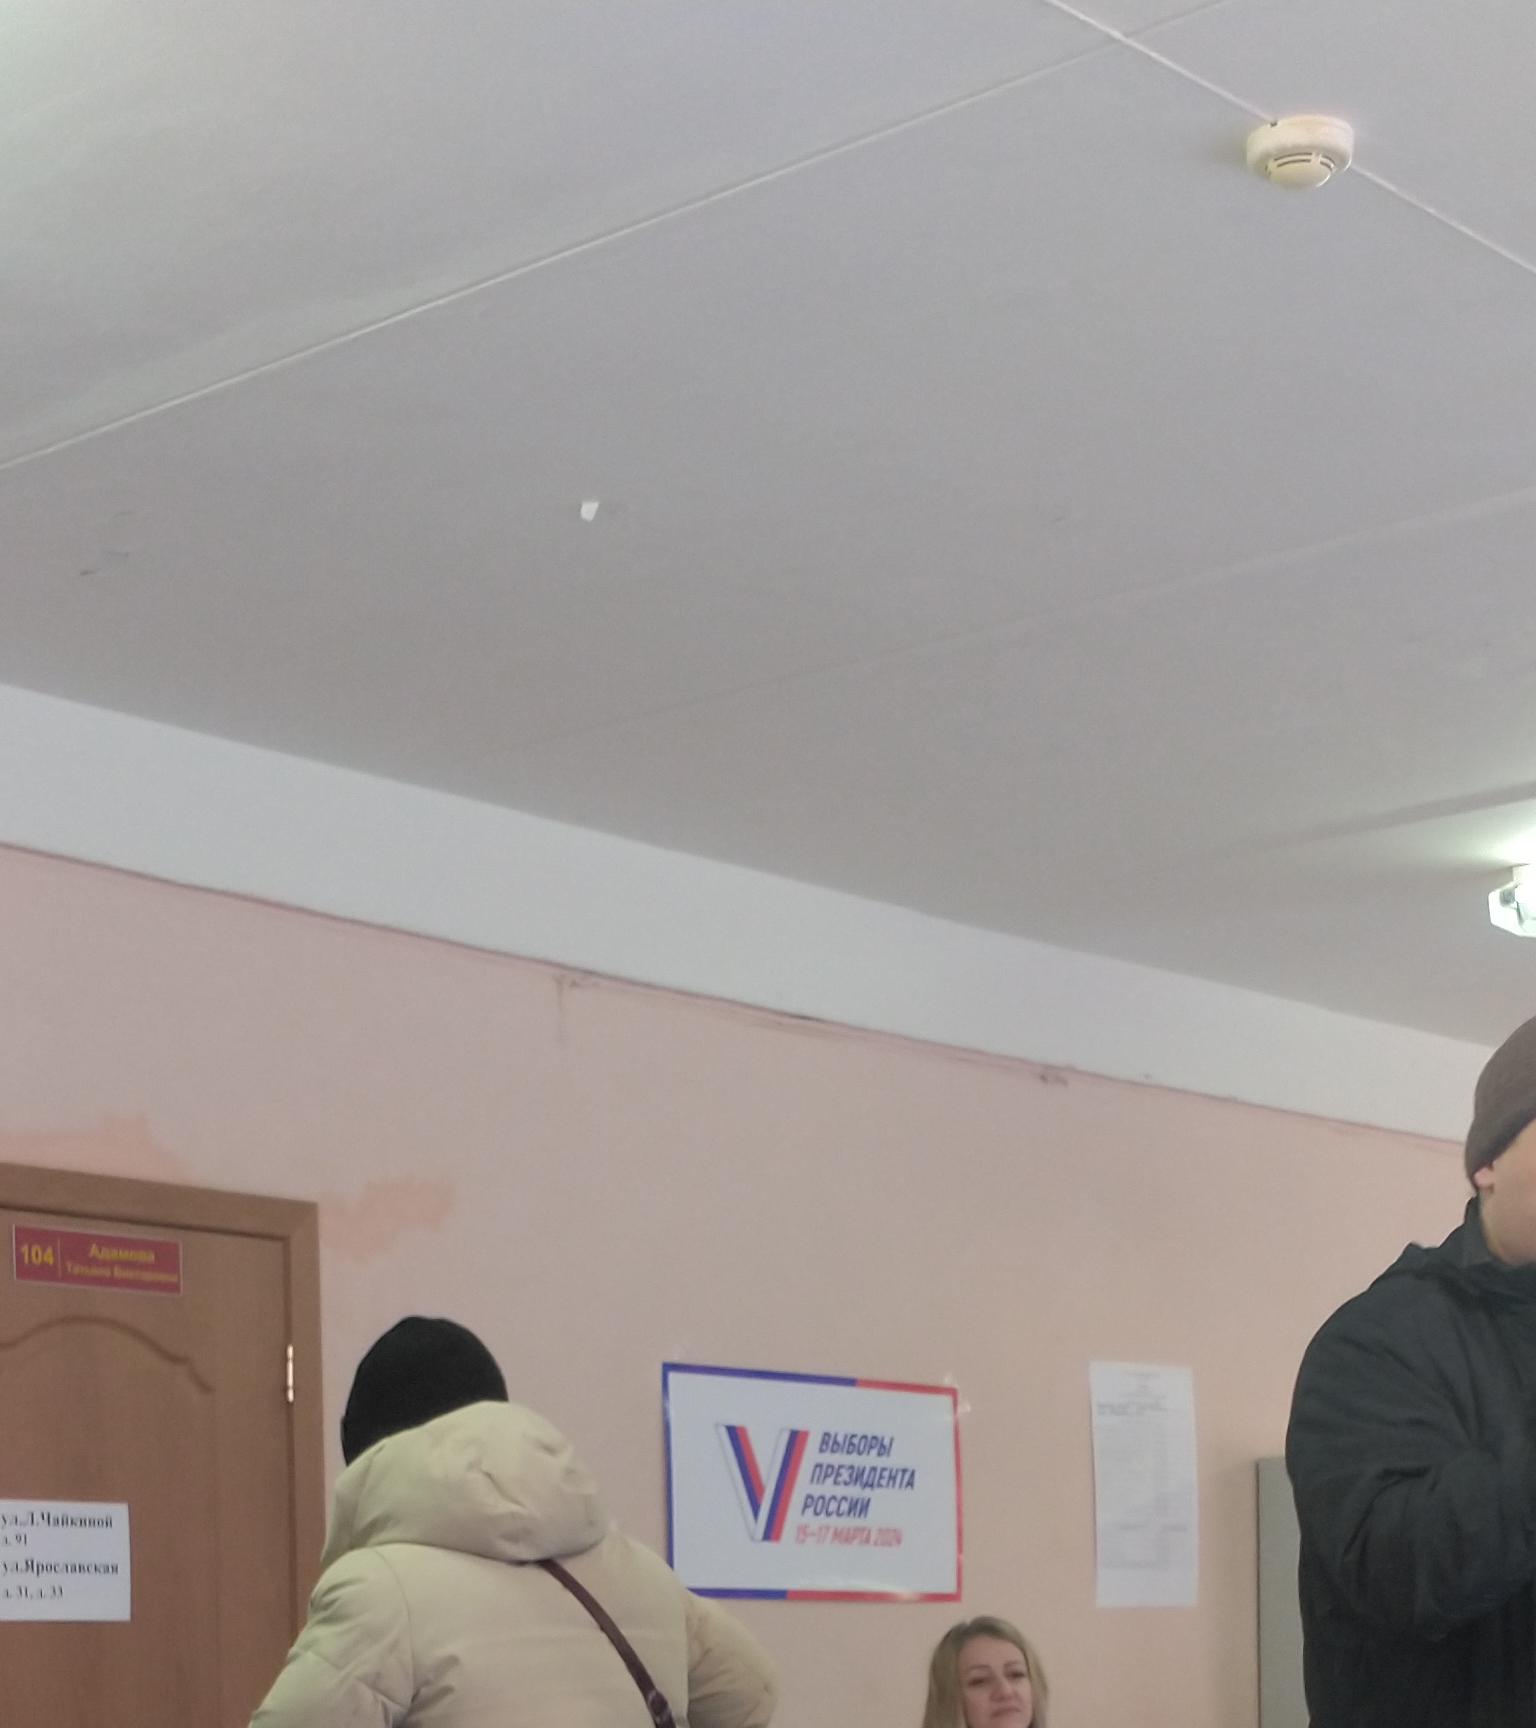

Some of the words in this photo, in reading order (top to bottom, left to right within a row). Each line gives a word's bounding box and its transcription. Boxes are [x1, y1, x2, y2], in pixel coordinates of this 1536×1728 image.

[21, 1244, 54, 1266] 104
[819, 1432, 894, 1458] ВЫБОРЫ
[810, 1462, 916, 1491] ПРЕЗИДЕНТА
[800, 1493, 872, 1519] РОССИИ
[831, 1526, 872, 1545] МАРТА
